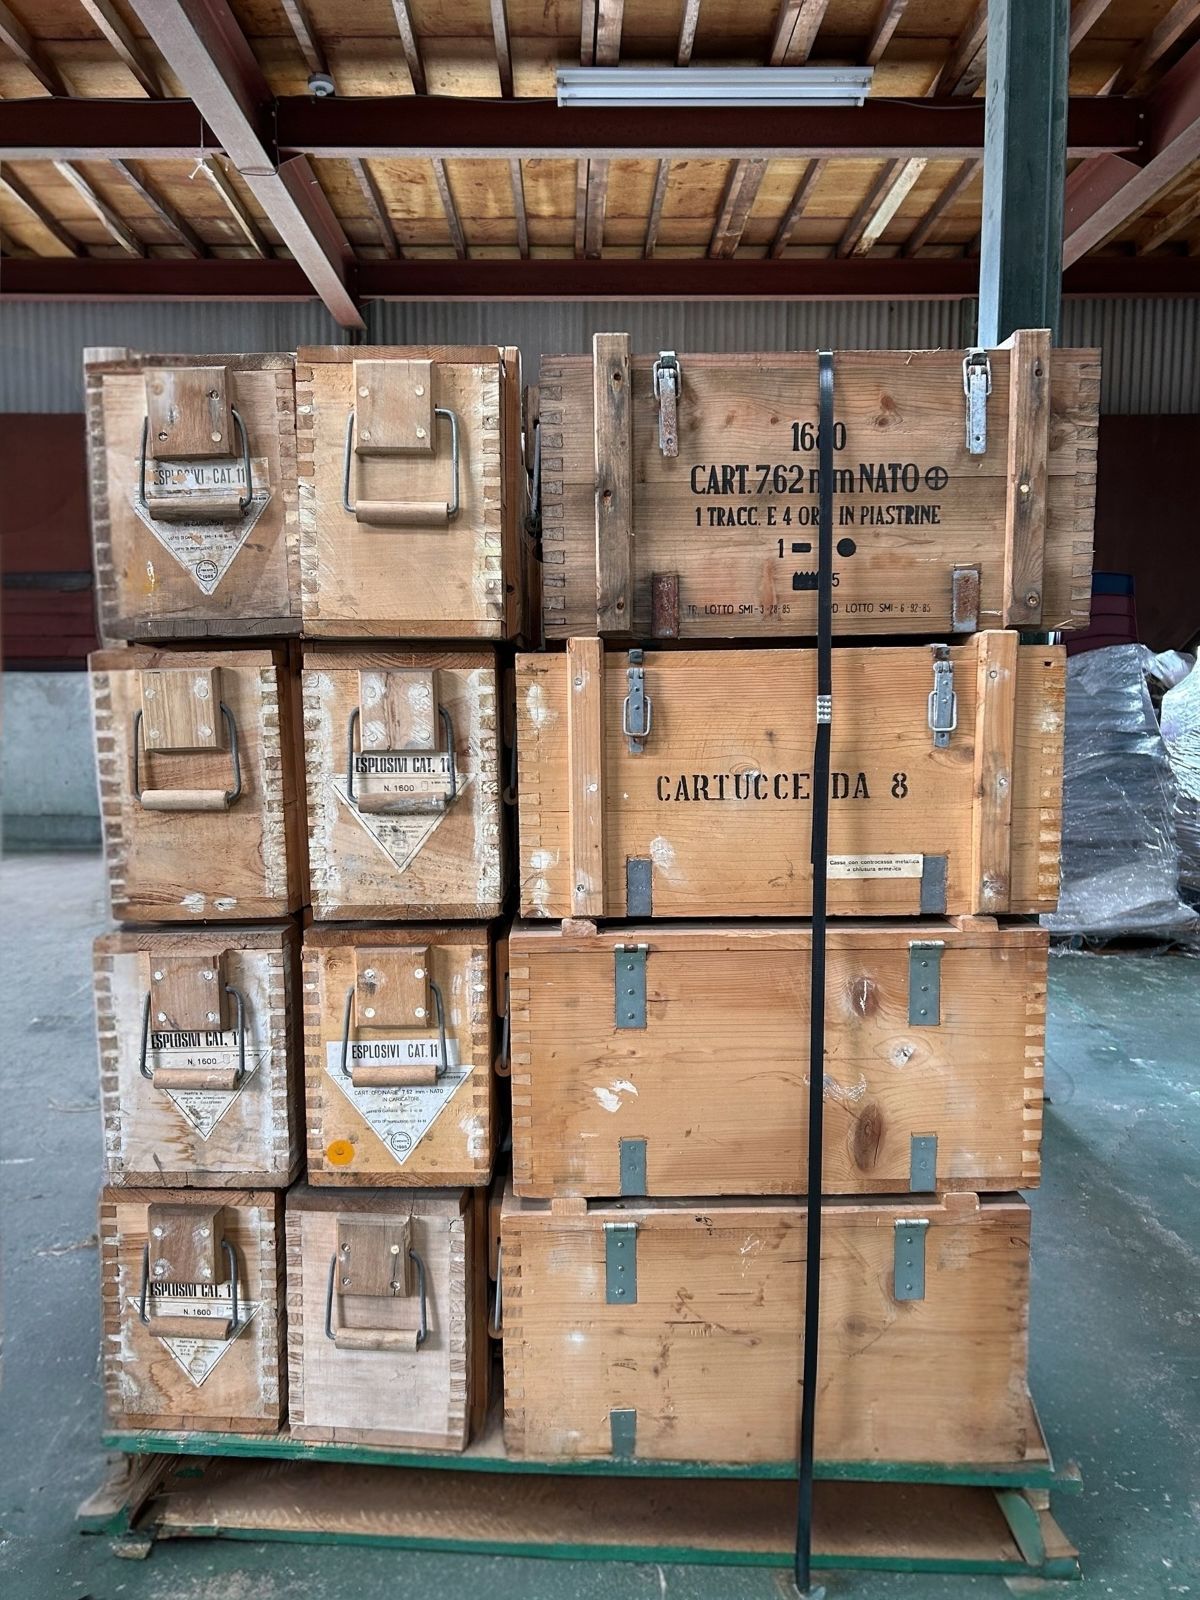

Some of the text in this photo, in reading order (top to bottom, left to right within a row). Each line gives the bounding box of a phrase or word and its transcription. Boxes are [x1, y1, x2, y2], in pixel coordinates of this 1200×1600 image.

[791, 422, 847, 452] 160
[690, 464, 752, 495] CART.
[859, 463, 920, 493] NATO
[695, 504, 941, 527] 1 TRACC. E 4 OR. IN PIASTRINE
[777, 538, 784, 559] 1
[704, 604, 734, 615] LOTTO
[845, 603, 874, 614] LOTTO
[355, 757, 408, 774] ESPLOSIVI
[412, 757, 436, 774] CAT.
[394, 784, 416, 793] 1600
[656, 772, 909, 802] CARTUCCE DA 8
[151, 1032, 201, 1049] ESPLOSIVI
[351, 1043, 400, 1059] ESPLOSIVI
